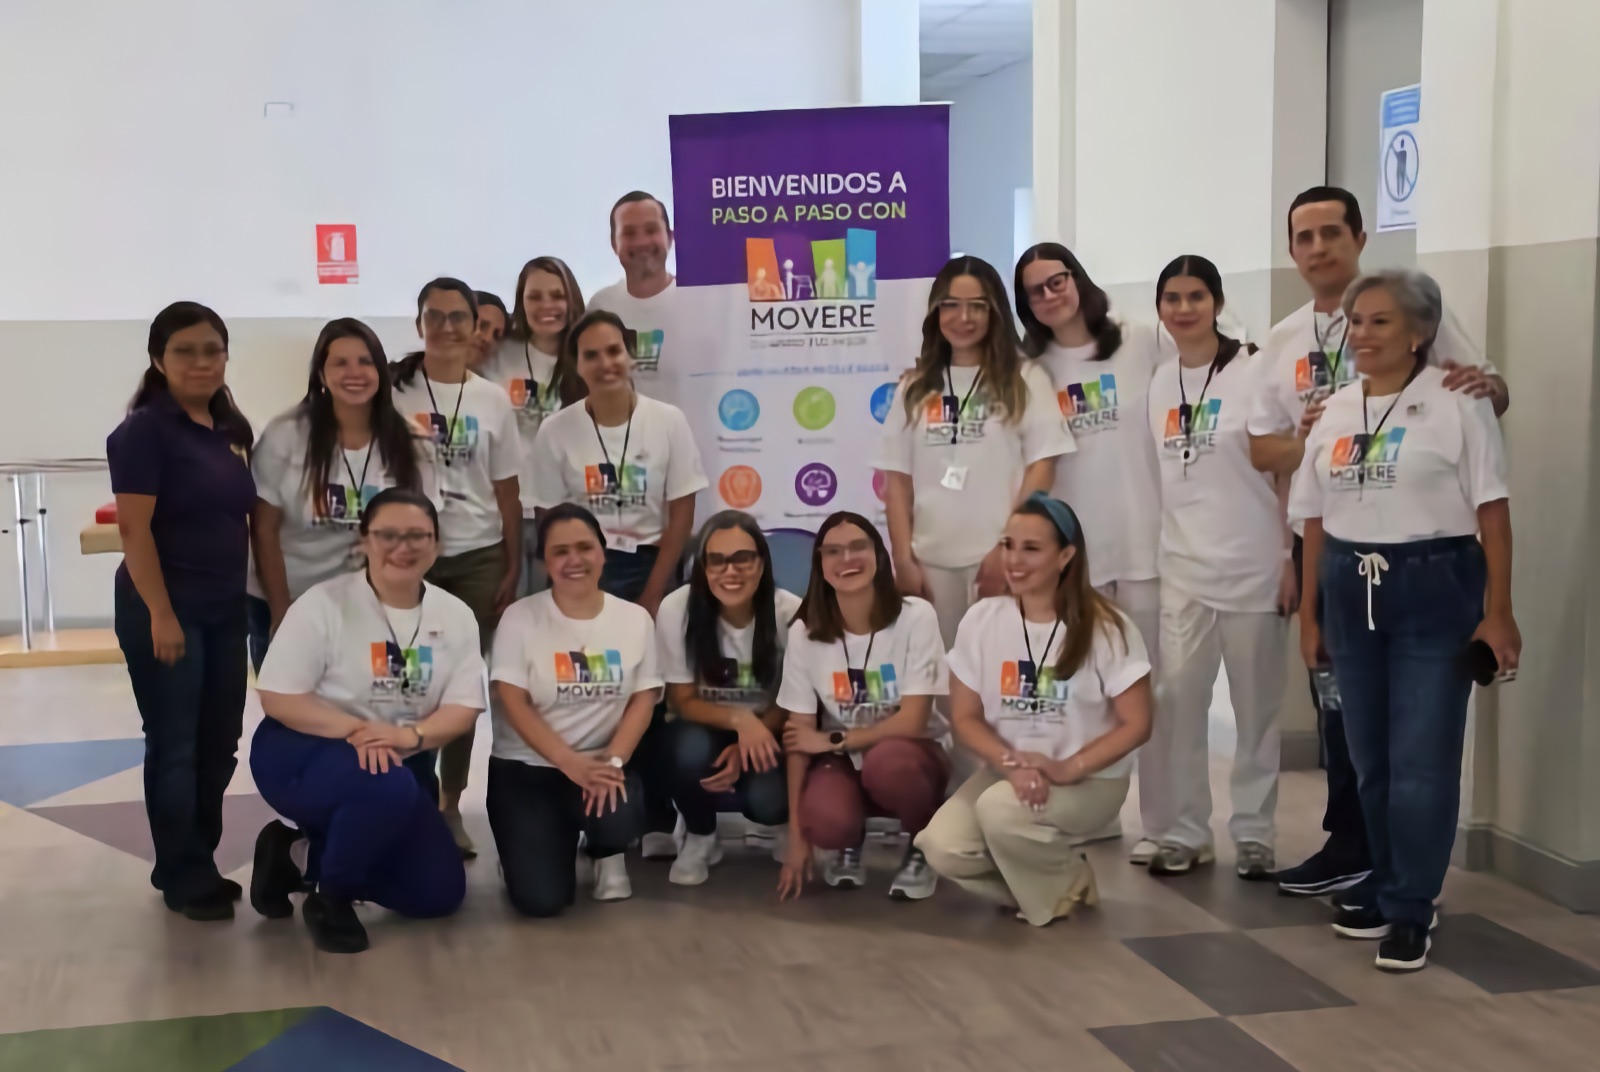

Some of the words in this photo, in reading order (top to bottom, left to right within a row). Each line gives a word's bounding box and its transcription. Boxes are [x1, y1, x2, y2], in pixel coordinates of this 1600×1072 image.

[711, 171, 882, 199] BIENVENIDOS
[888, 170, 907, 194] A
[711, 205, 768, 226] PASO
[773, 205, 789, 223] A
[795, 202, 852, 222] PASO
[858, 200, 906, 220] CON
[750, 303, 875, 331] MOVERE
[926, 421, 985, 439] MOERE
[1001, 697, 1067, 717] MOERE
